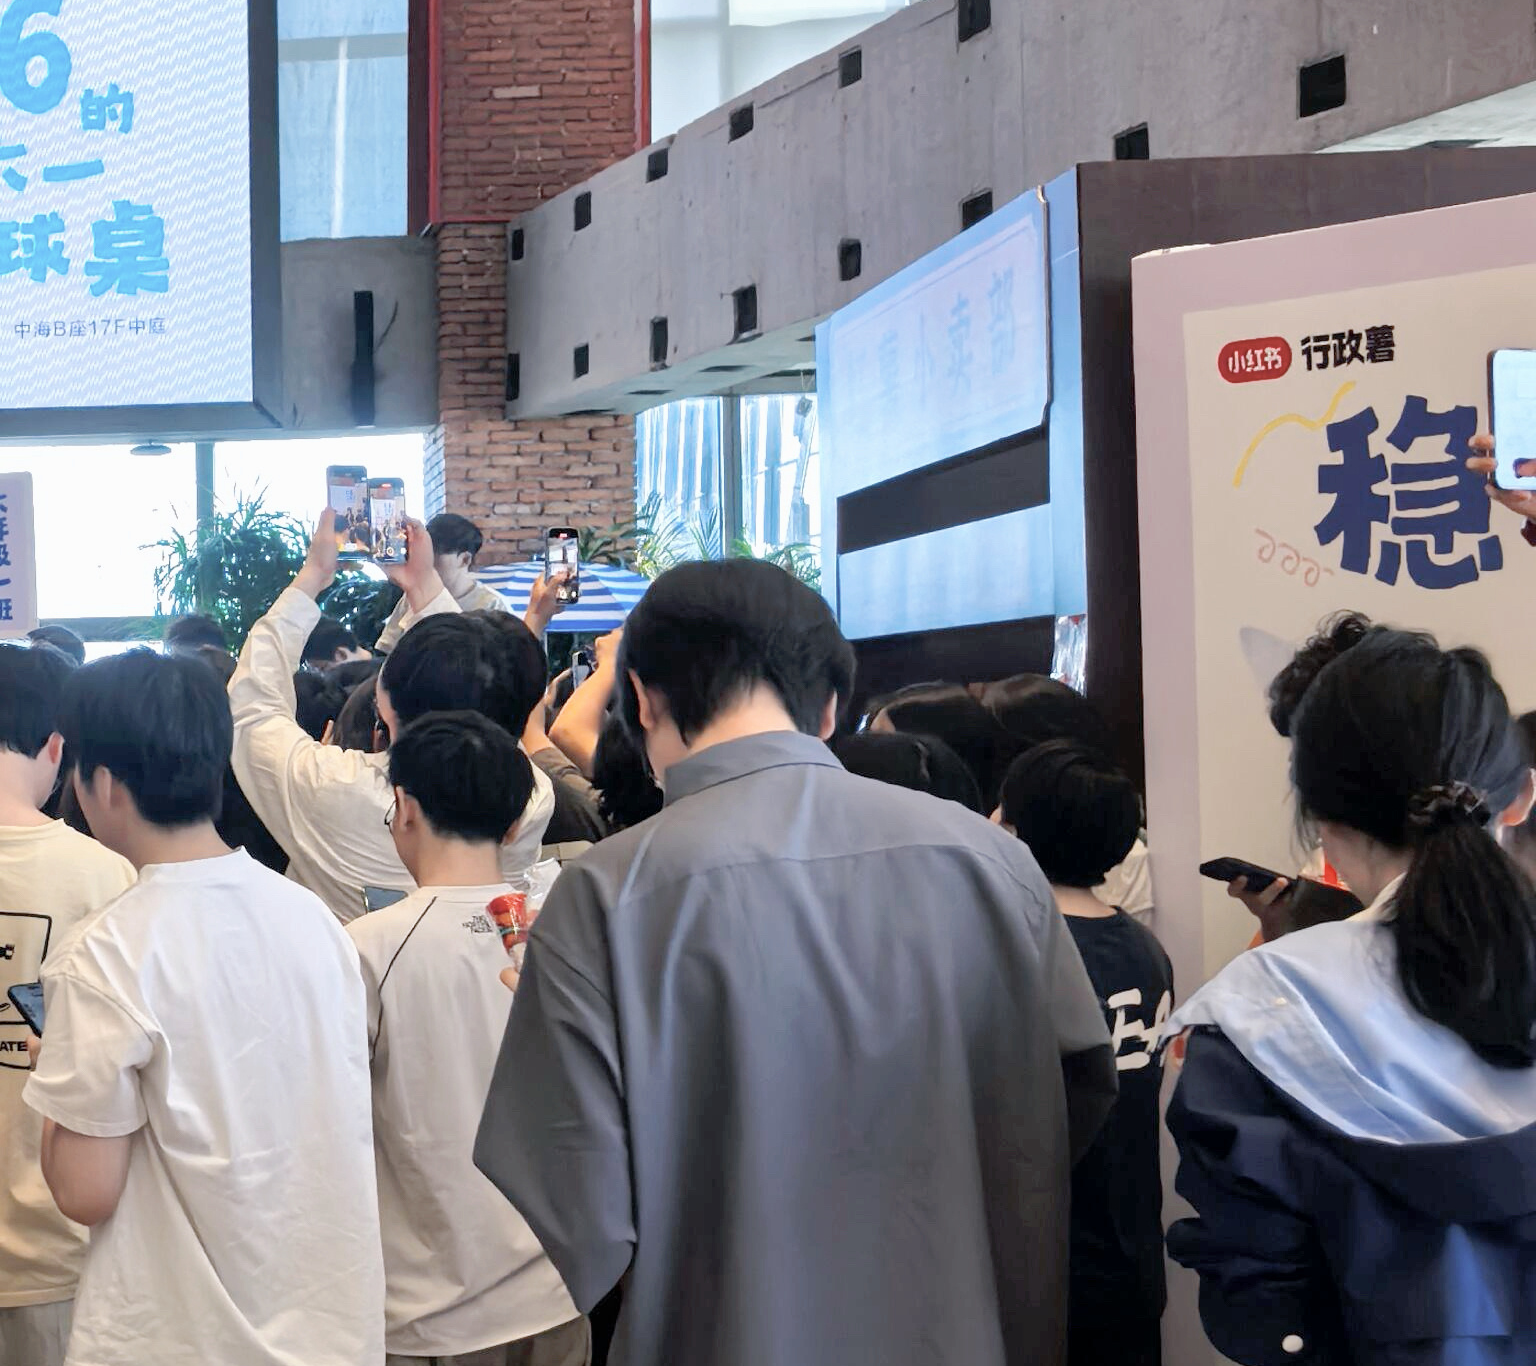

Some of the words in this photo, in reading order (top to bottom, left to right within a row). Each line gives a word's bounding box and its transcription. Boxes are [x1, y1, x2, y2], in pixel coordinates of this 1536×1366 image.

[14, 316, 166, 339] 中海B座17F中庭
[1228, 346, 1283, 373] 小红书
[1300, 325, 1395, 372] 行政薯
[1314, 395, 1503, 590] 稳
